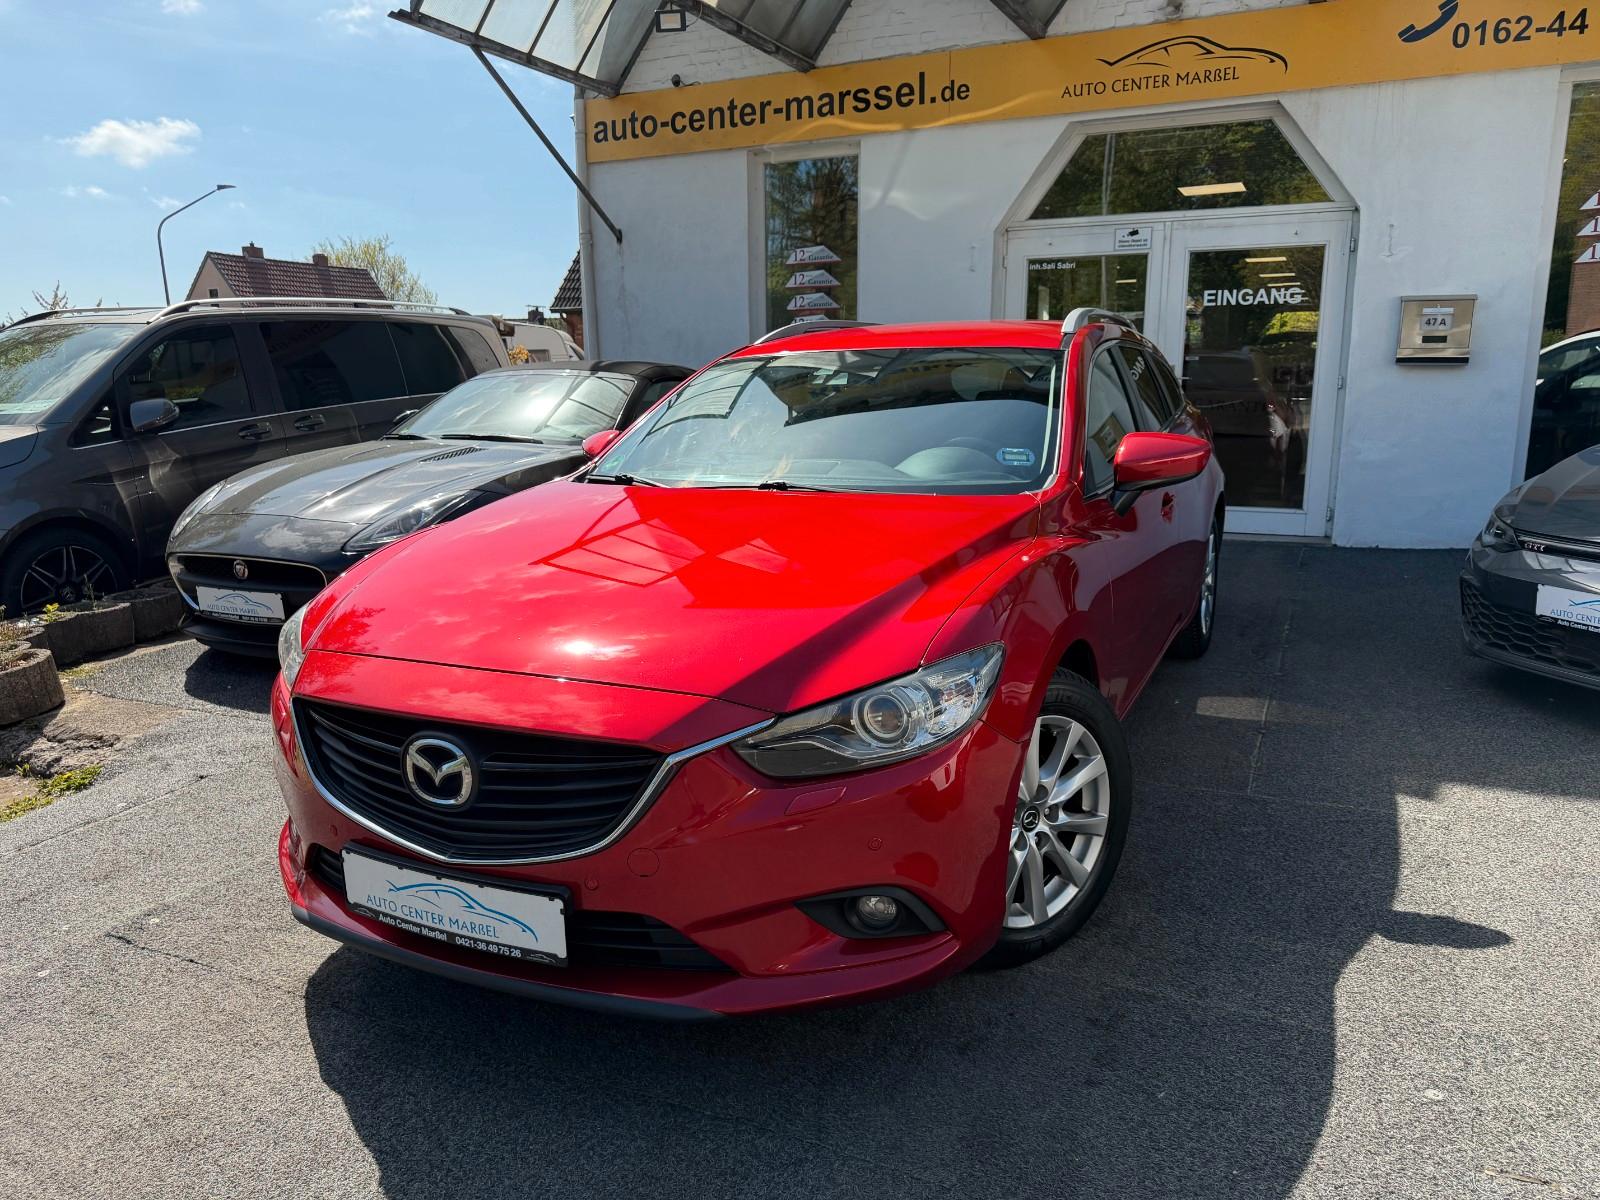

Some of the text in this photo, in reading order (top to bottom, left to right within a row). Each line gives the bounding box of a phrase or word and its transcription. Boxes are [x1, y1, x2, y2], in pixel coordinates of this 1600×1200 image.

[1452, 8, 1589, 49] 0162-44
[1061, 81, 1106, 99] AUTO
[1111, 74, 1171, 95] CENTER
[593, 71, 971, 144] auto-center-marssel.de
[1203, 287, 1303, 306] EINGANG
[1424, 317, 1447, 326] 47 A
[1551, 609, 1574, 619] AUTO
[366, 894, 398, 913] AUTO
[400, 904, 445, 928] CENTER
[378, 913, 396, 926] Auto
[397, 919, 421, 935] Center
[455, 936, 487, 951] 0421-36
[488, 944, 499, 954] 49
[499, 947, 510, 956] 75
[510, 949, 522, 958] 26
